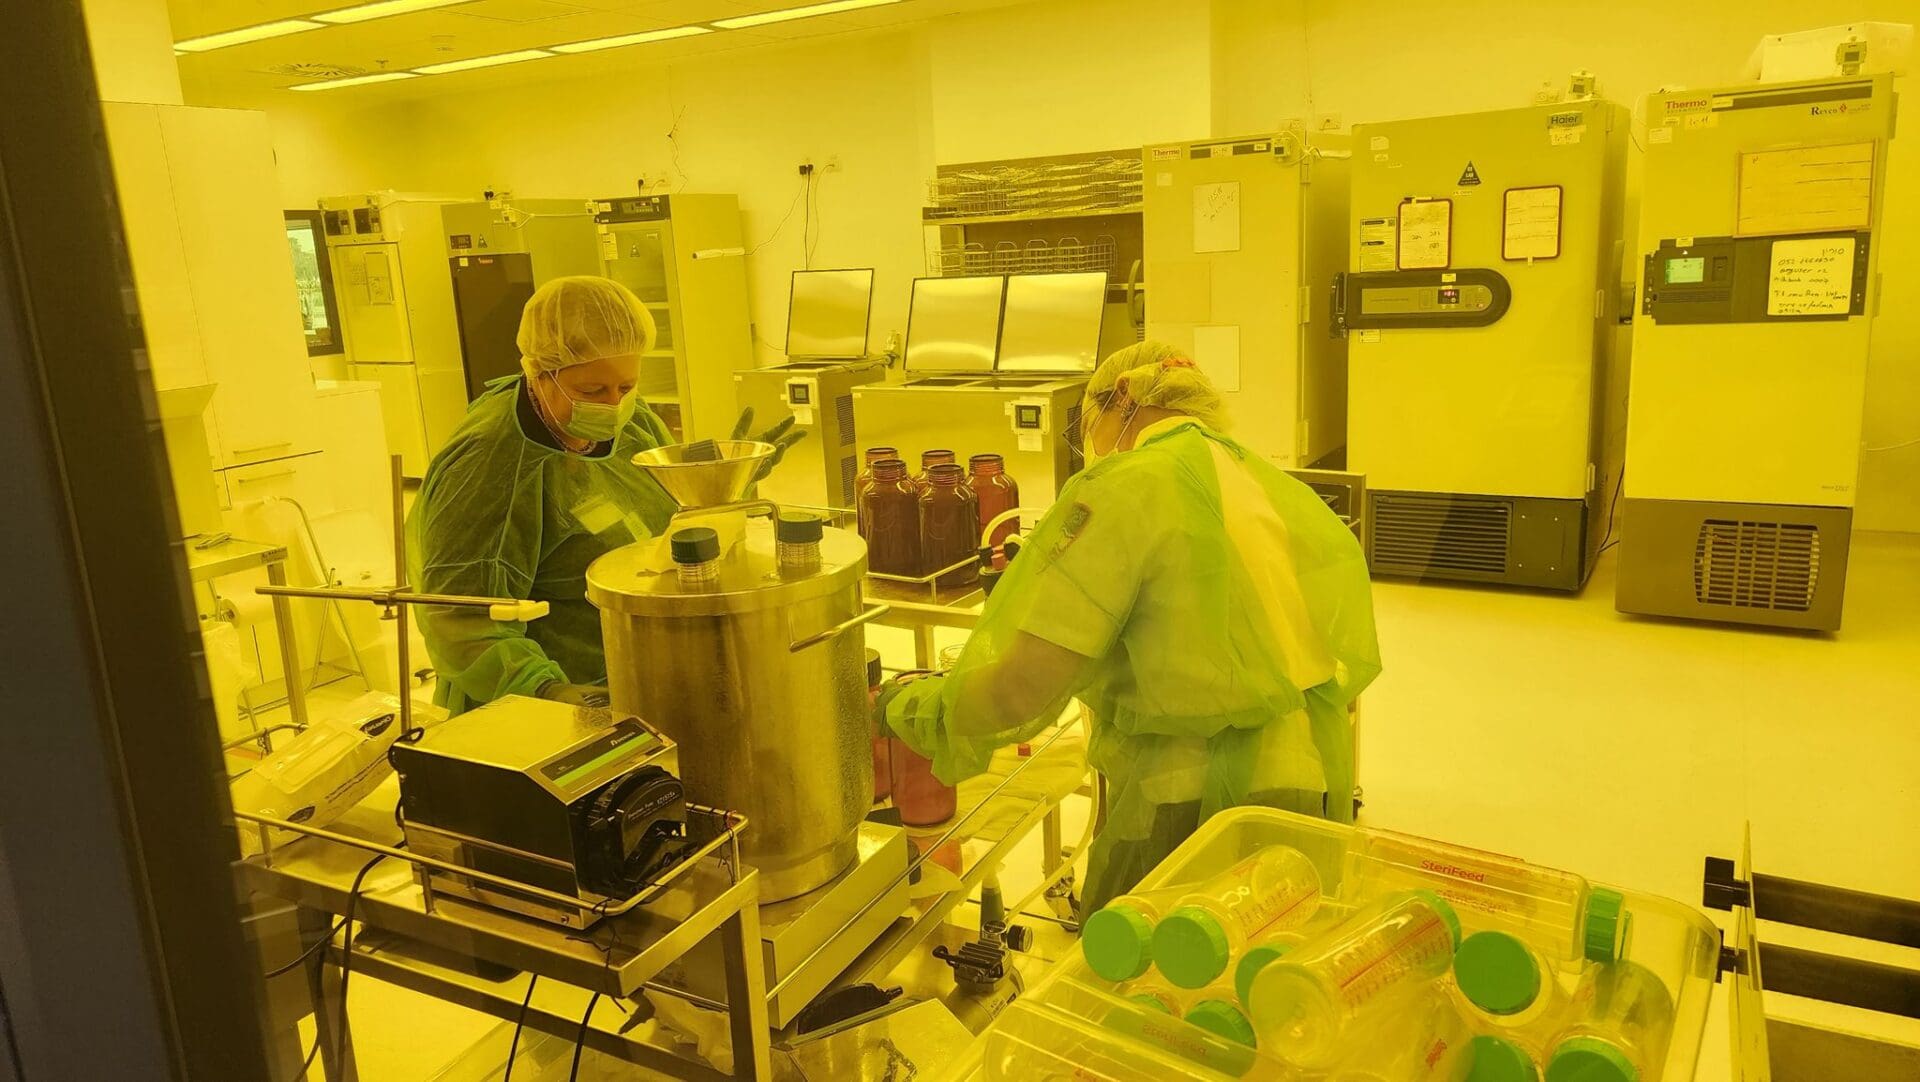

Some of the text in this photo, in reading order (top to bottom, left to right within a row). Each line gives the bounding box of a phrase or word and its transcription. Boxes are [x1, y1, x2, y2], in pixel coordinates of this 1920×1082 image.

[1664, 99, 1707, 110] Thermo
[1551, 115, 1578, 125] Haier
[1420, 858, 1485, 883] SteriFeed
